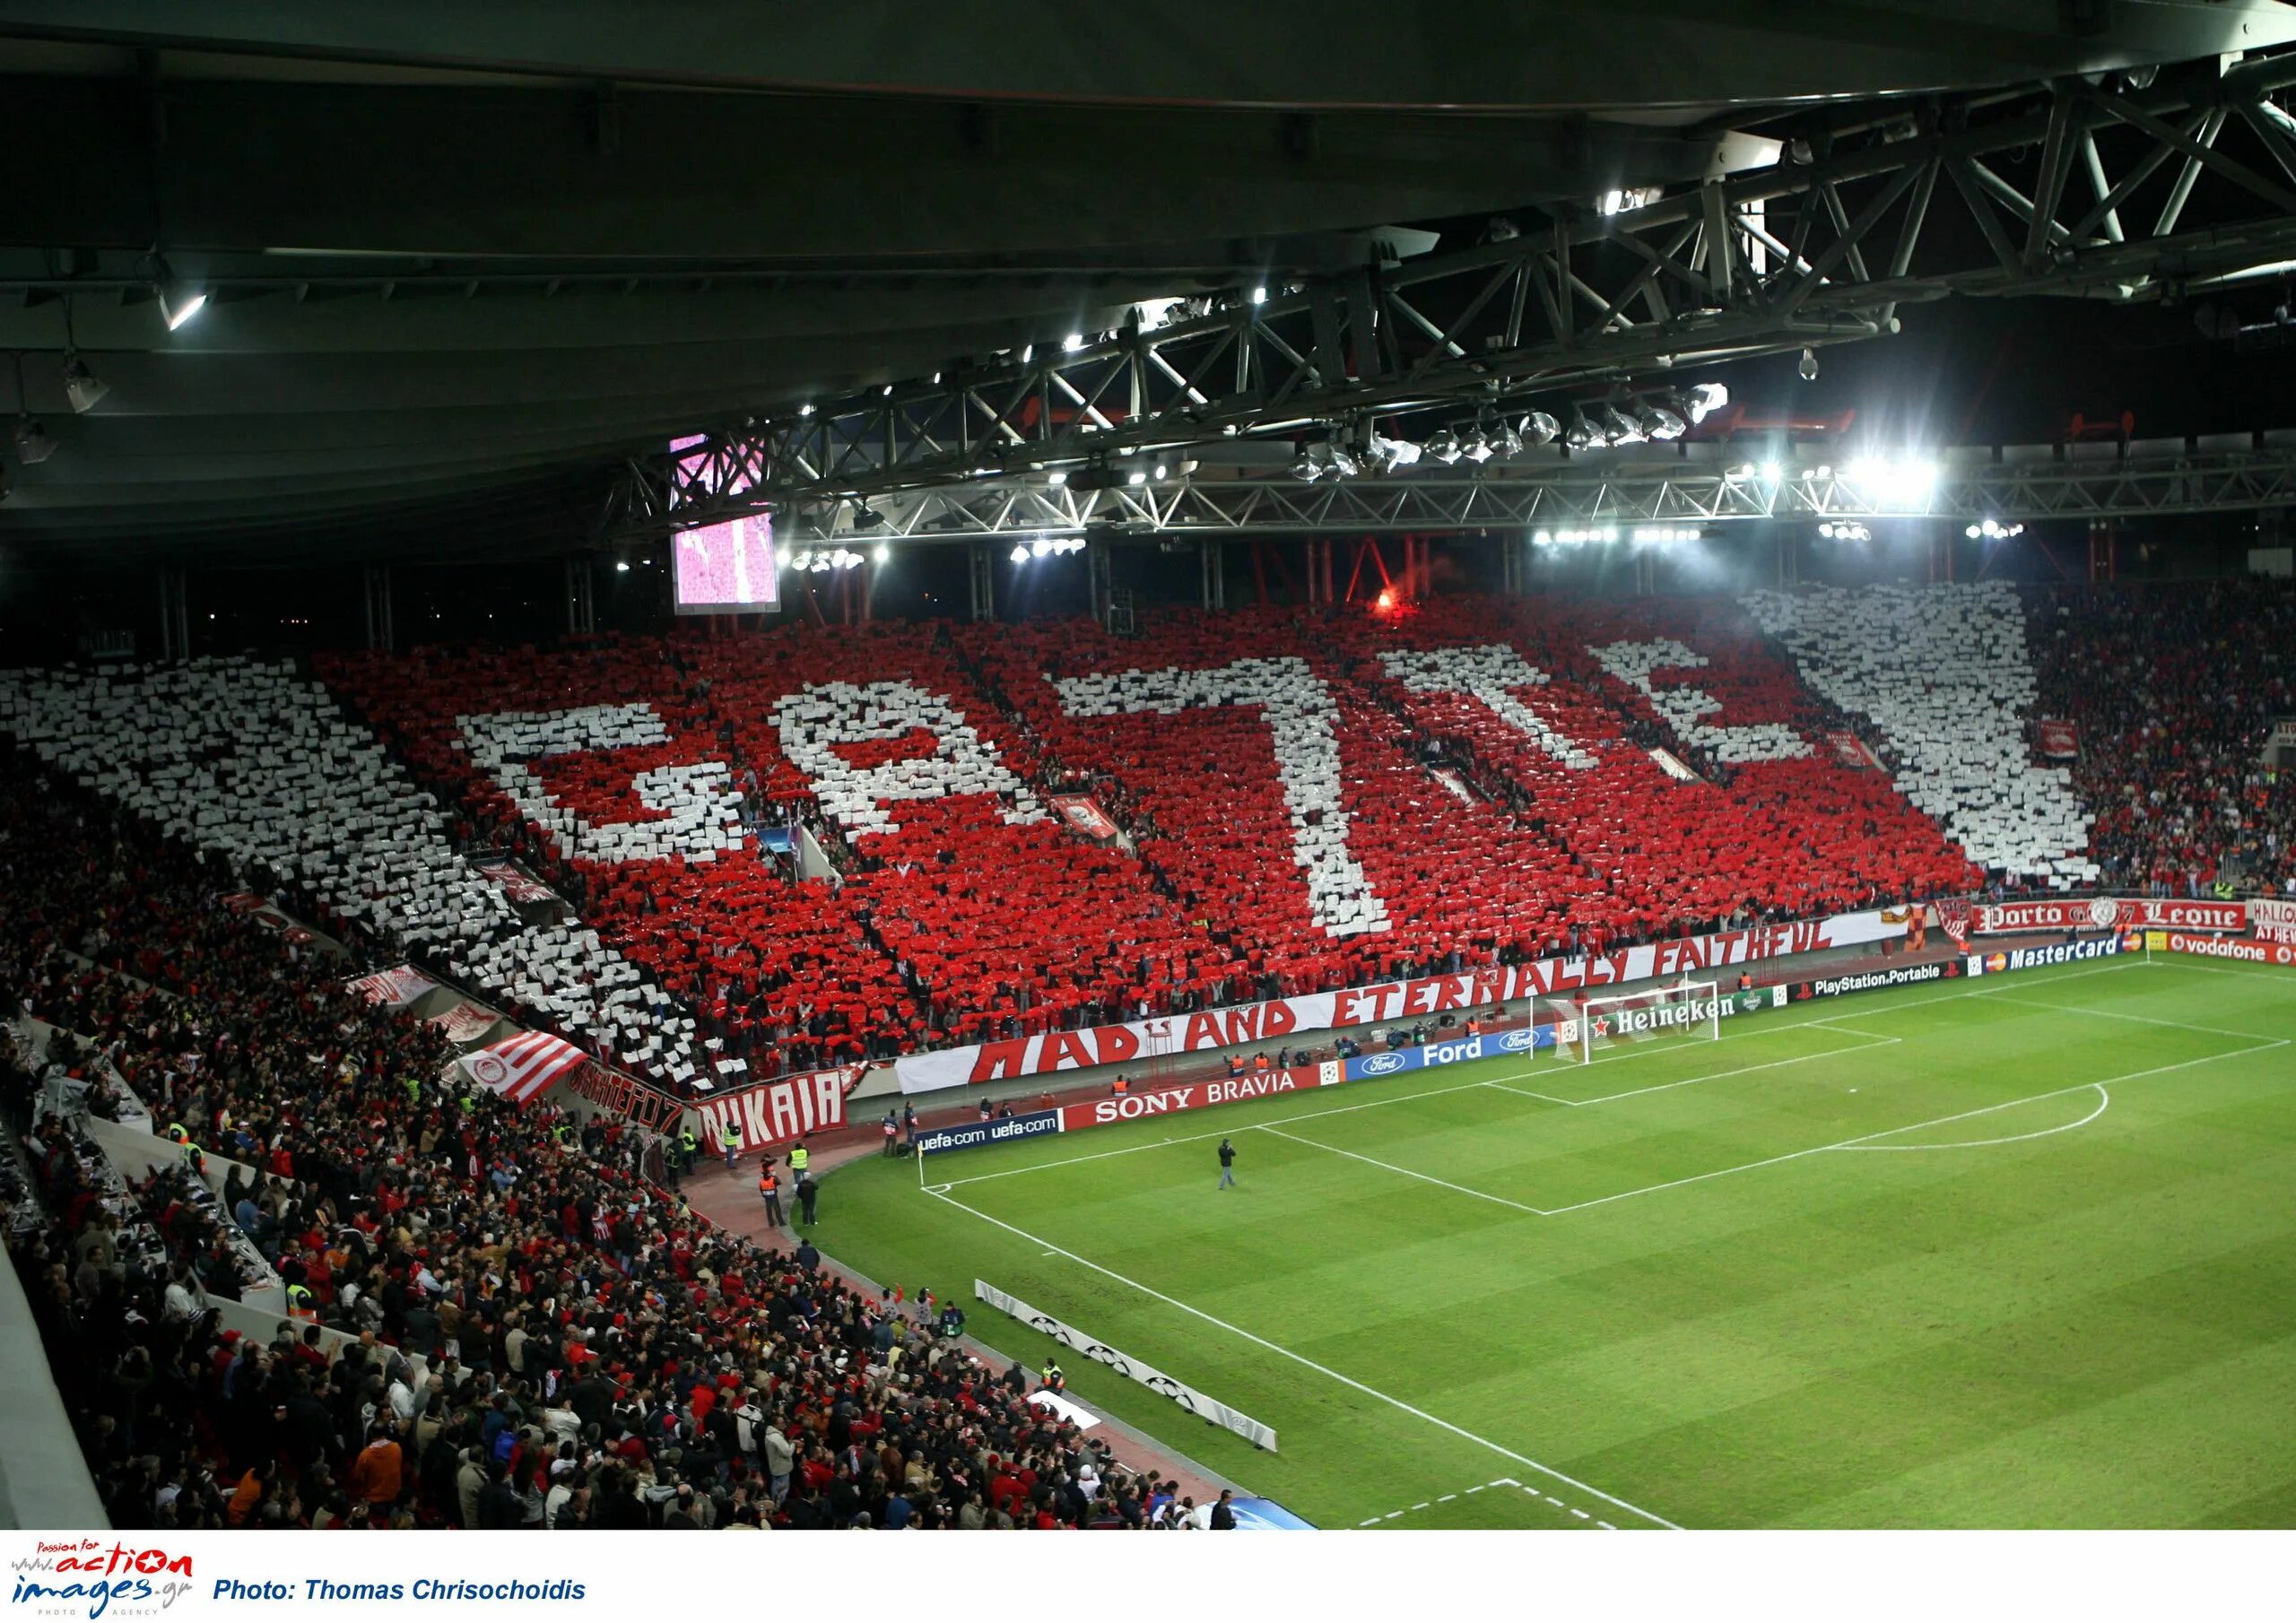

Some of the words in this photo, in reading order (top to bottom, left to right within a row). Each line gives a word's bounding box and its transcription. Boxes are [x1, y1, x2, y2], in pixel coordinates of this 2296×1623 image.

[1979, 904, 2063, 933] Porto
[2141, 902, 2239, 927] Leone
[2010, 936, 2118, 969] MasterCard
[2187, 937, 2266, 961] vodafone
[969, 1024, 1139, 1084] MAD
[1184, 1000, 1297, 1052] AND
[1330, 947, 1631, 1028] ETERNALLY
[1654, 921, 1834, 976] FAITHFUL
[1617, 997, 1735, 1034] Heineken
[1370, 1055, 1396, 1072] Ford
[1423, 1037, 1482, 1067] Ford
[1508, 1032, 1535, 1047] Ford
[698, 1071, 841, 1152] NIKAIA
[1095, 1088, 1194, 1123] SONY
[1207, 1072, 1295, 1104] BRAVIA
